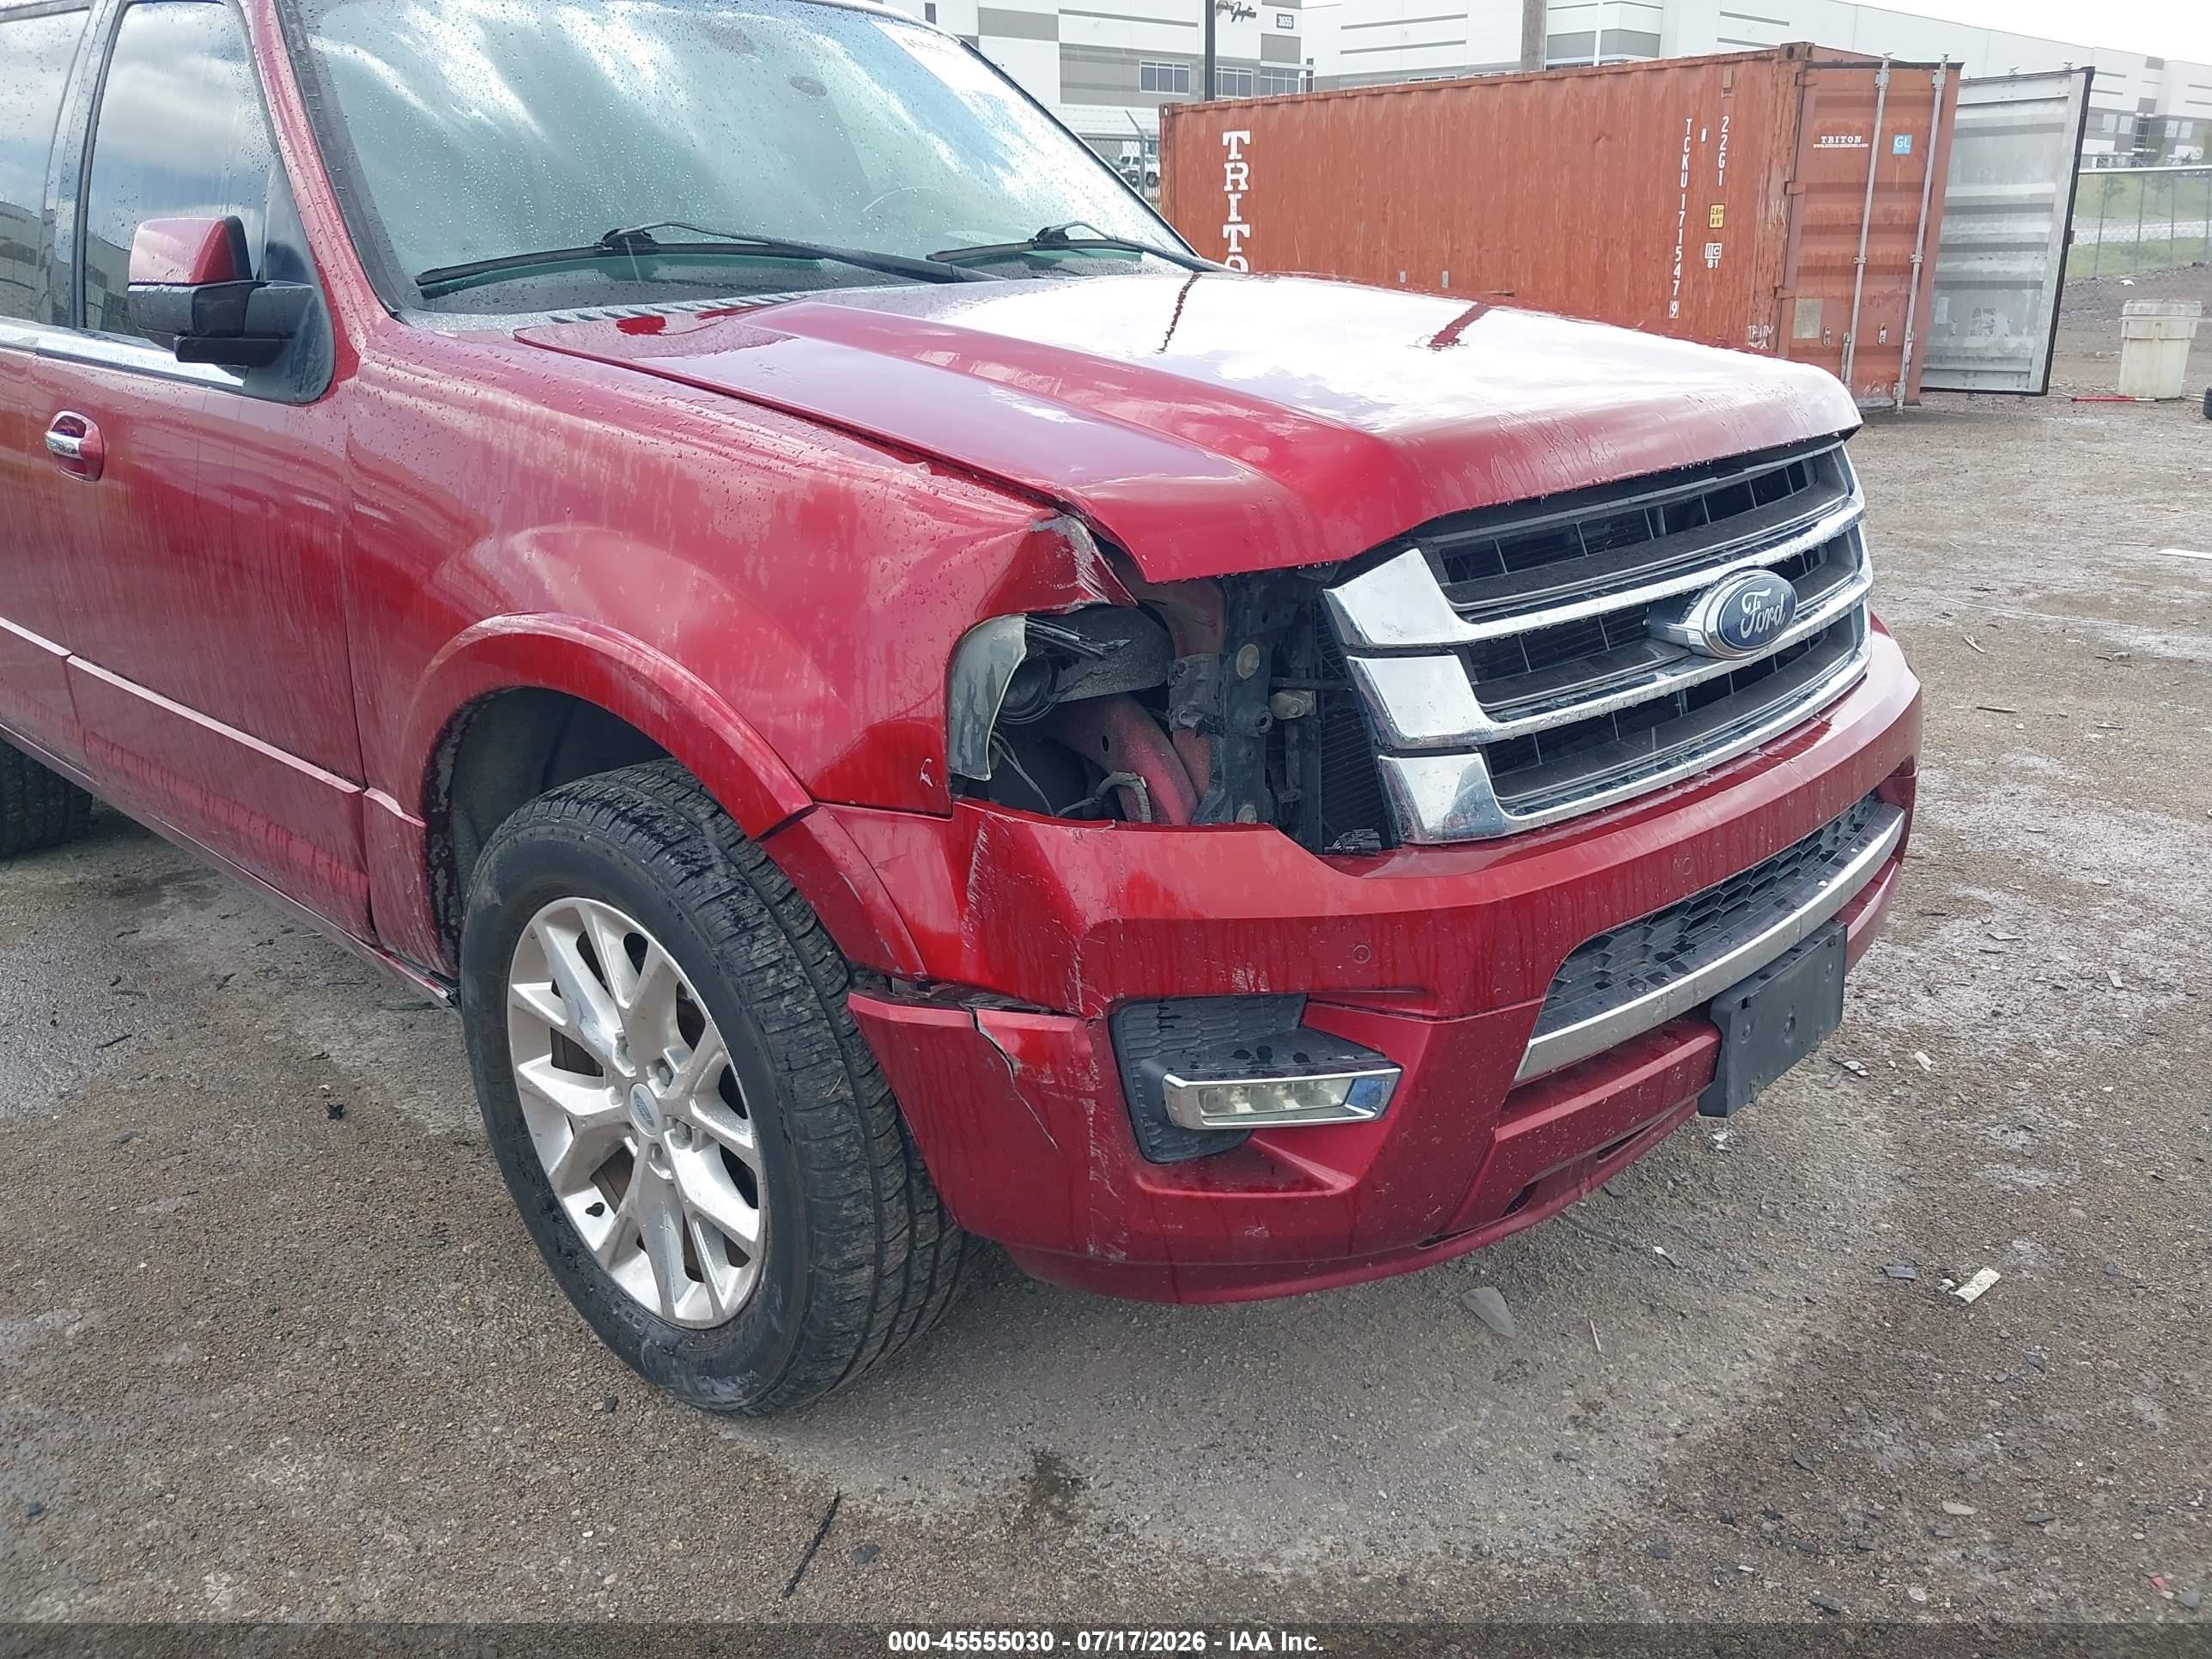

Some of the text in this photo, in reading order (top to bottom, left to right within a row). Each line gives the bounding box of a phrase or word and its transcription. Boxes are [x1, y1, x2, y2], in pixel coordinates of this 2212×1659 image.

[1680, 118, 1692, 188] TCKU
[1718, 115, 1729, 186] 22G1
[1820, 135, 1862, 143] TRITON
[1895, 137, 1911, 148] GL
[1674, 193, 1686, 295] 171547
[1707, 259, 1718, 268] 81
[1740, 587, 1786, 639] Ford
